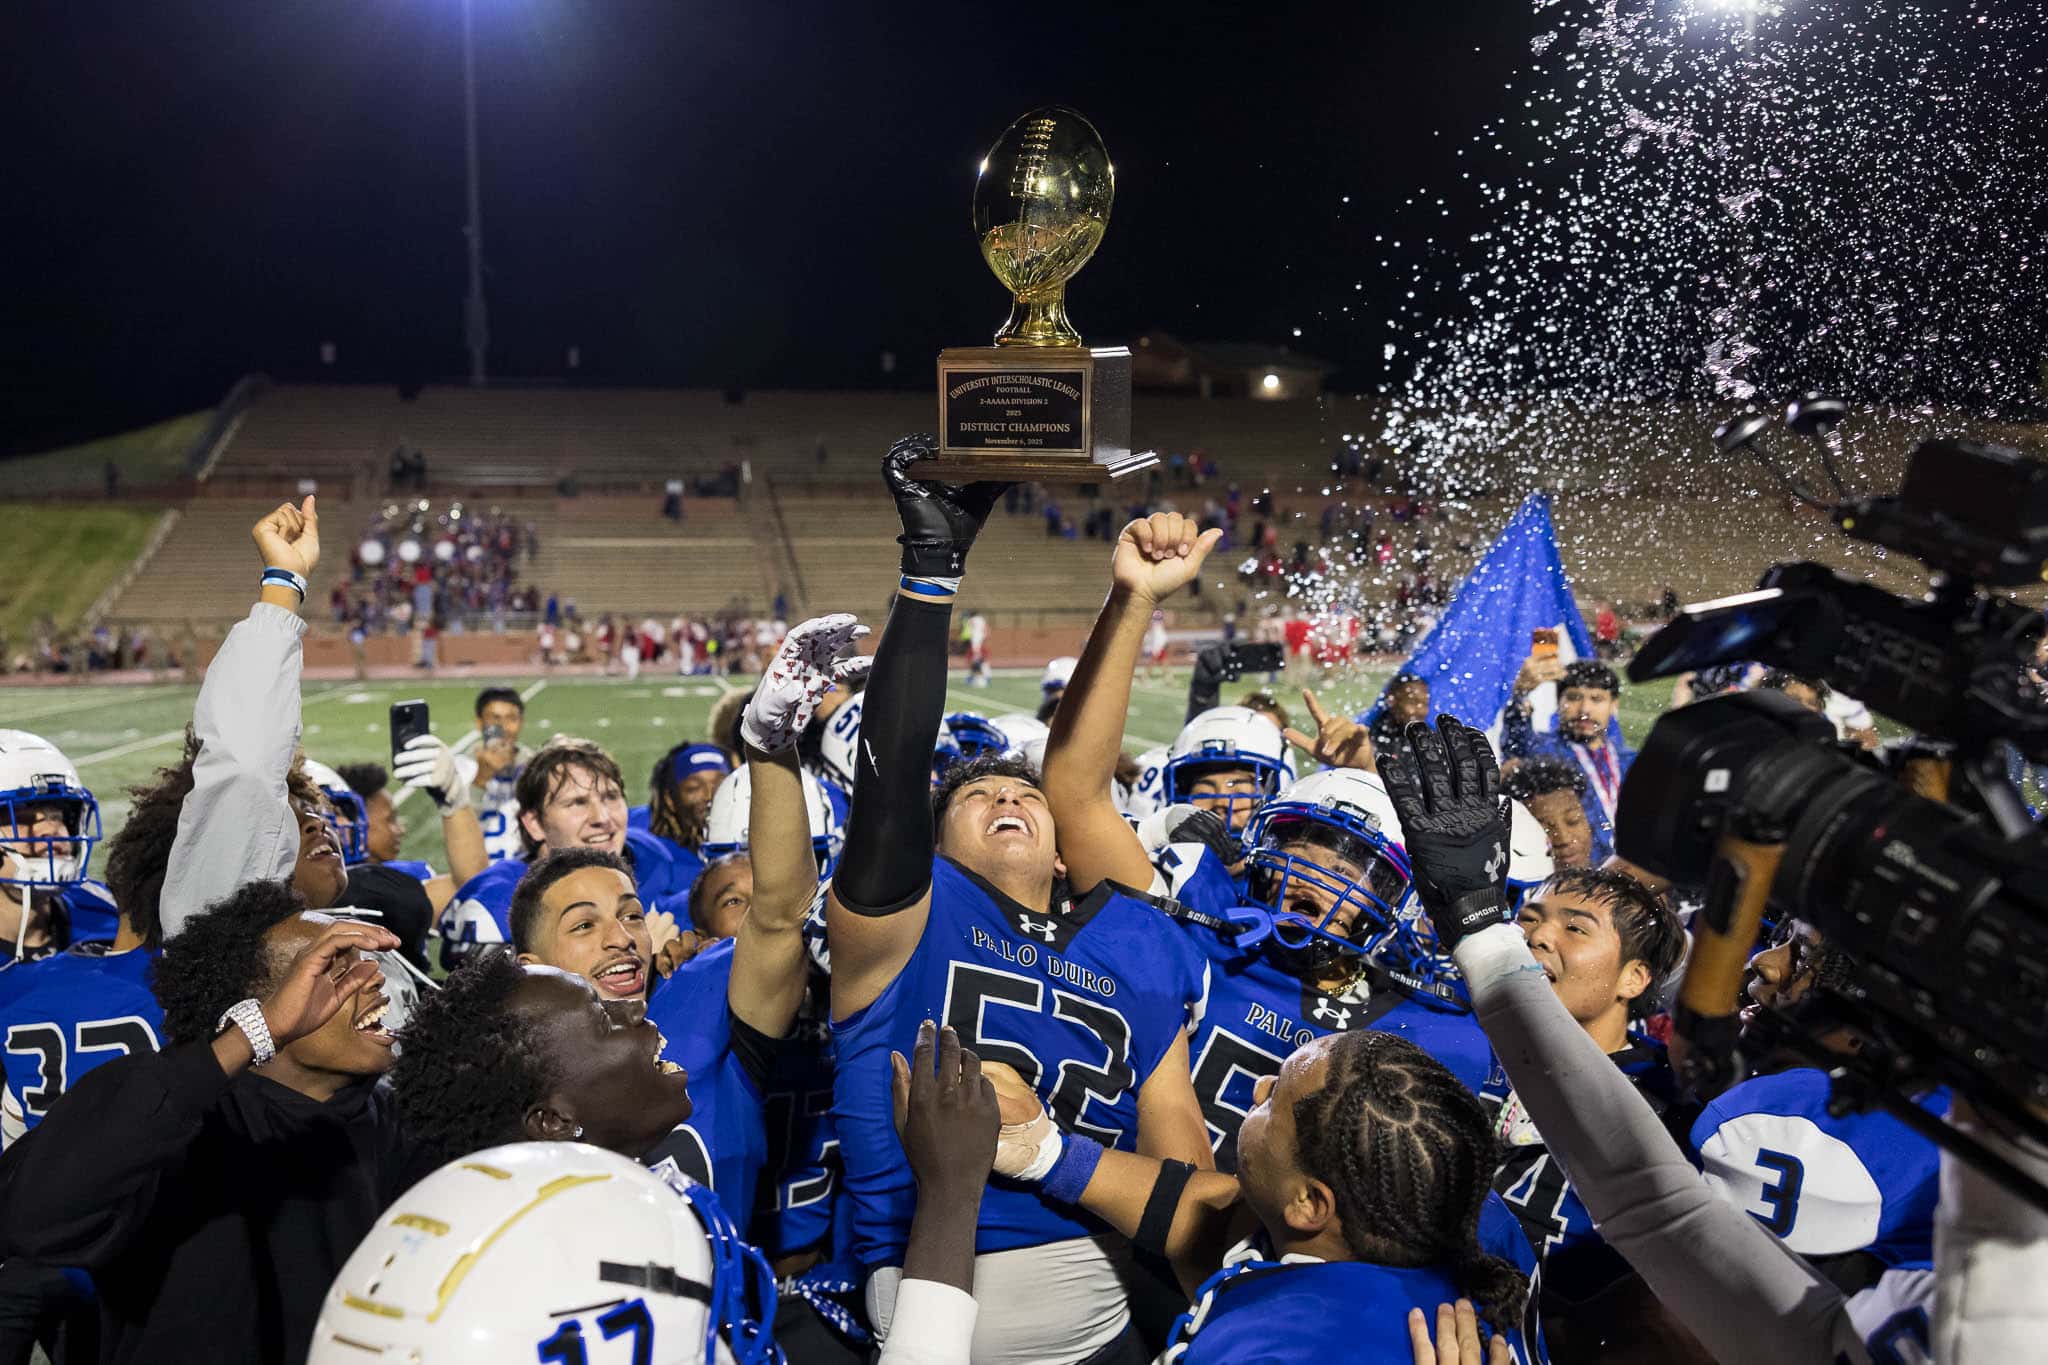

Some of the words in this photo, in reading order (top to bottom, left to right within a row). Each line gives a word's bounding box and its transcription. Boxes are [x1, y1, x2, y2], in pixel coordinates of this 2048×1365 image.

[950, 377, 990, 399] UNIVERSITY
[991, 375, 1053, 388] INTERSCHOLASTIC
[1053, 380, 1081, 401] LEAGUE
[960, 422, 1007, 432] DISTRICT
[1009, 423, 1071, 432] CHAMPIONS
[985, 437, 1017, 445] November
[971, 926, 1038, 967] PALO
[1047, 955, 1116, 998] DURO
[1389, 970, 1423, 990] schutt
[1244, 1002, 1315, 1049] PALO
[941, 959, 1136, 1149] 52
[1745, 1147, 1805, 1239] 3
[536, 1298, 655, 1365] 17
